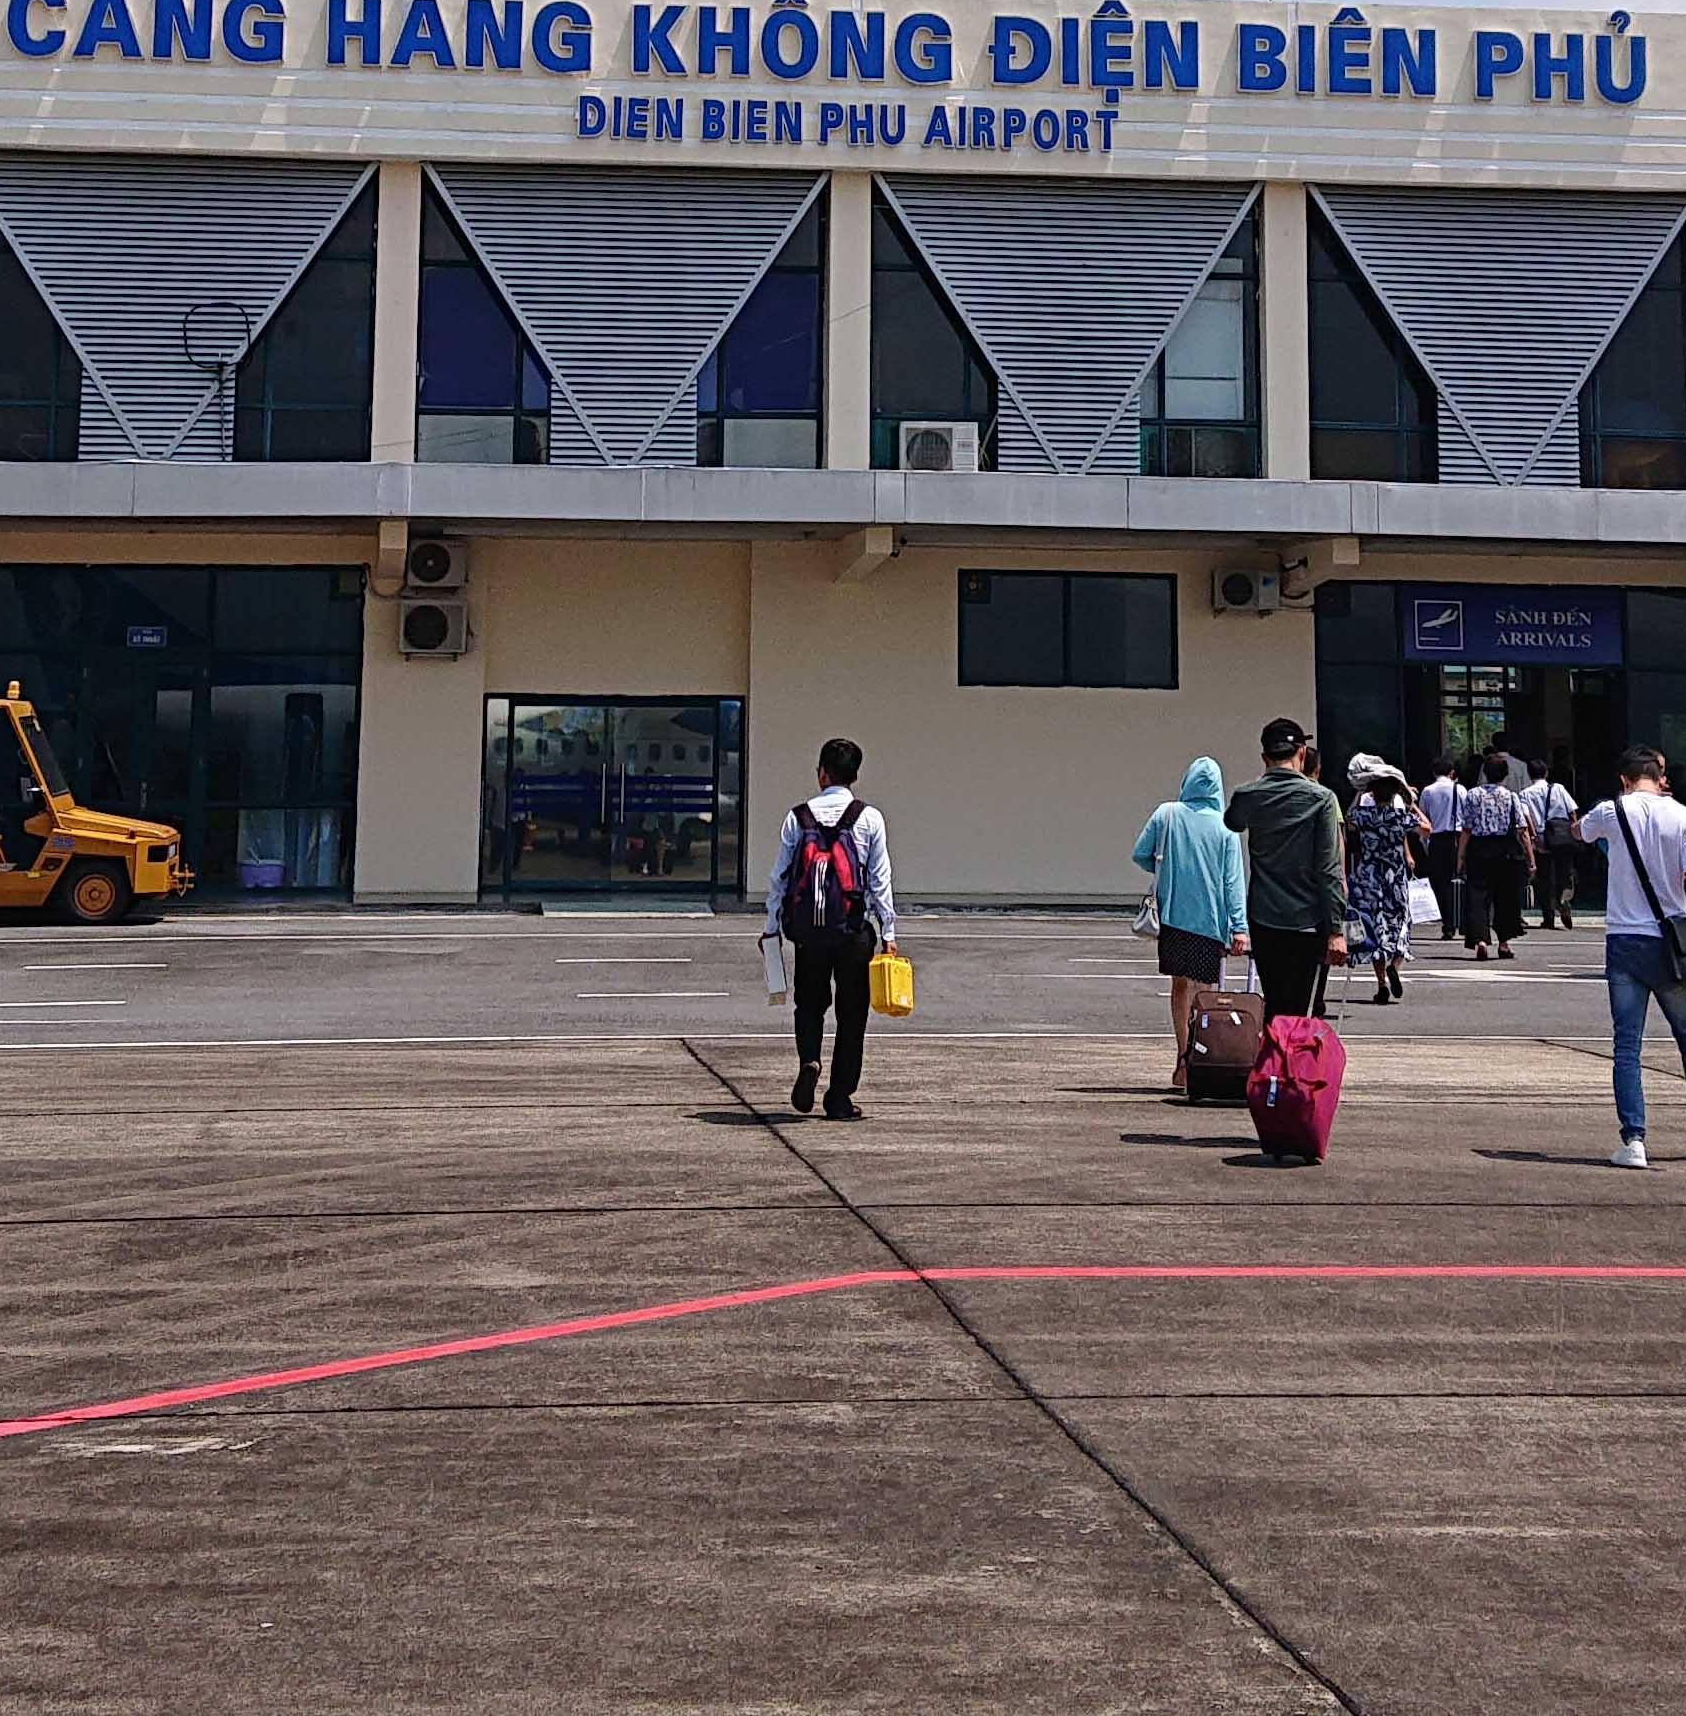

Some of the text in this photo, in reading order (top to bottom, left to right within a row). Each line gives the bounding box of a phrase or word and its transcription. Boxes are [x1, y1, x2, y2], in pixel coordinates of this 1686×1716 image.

[988, 0, 1200, 104] ĐIỆN
[1237, 7, 1436, 97] BIÊN
[1474, 10, 1646, 105] PHỦ
[702, 98, 803, 144] BIEN
[818, 102, 906, 147] PHU
[922, 105, 1119, 152] AIRPORT
[1553, 606, 1593, 627] ĐẾN
[1496, 631, 1594, 648] ARRIVALS
